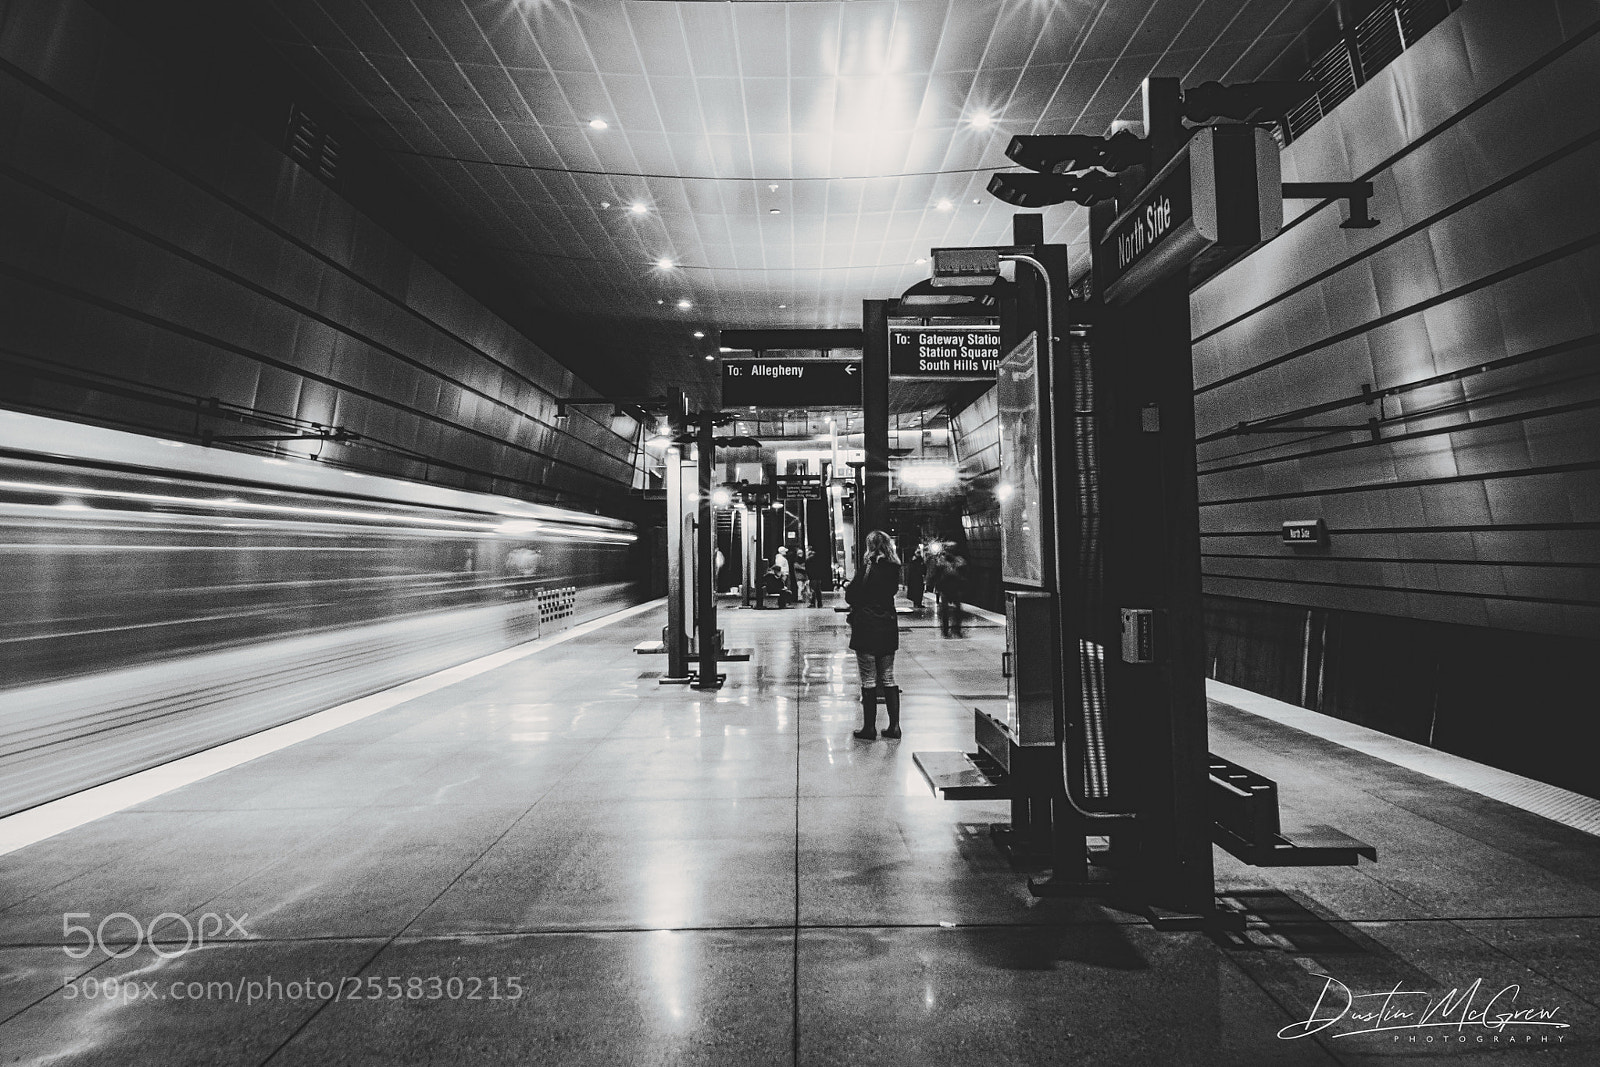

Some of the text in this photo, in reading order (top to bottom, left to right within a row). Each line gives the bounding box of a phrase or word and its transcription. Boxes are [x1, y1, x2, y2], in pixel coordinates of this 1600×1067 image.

[1118, 194, 1171, 269] North Side
[894, 333, 911, 345] To:
[918, 333, 964, 347] Gateway
[919, 346, 999, 360] Station Square
[727, 364, 804, 378] To: Allegheny
[919, 359, 950, 371] South
[953, 359, 979, 371] Hills
